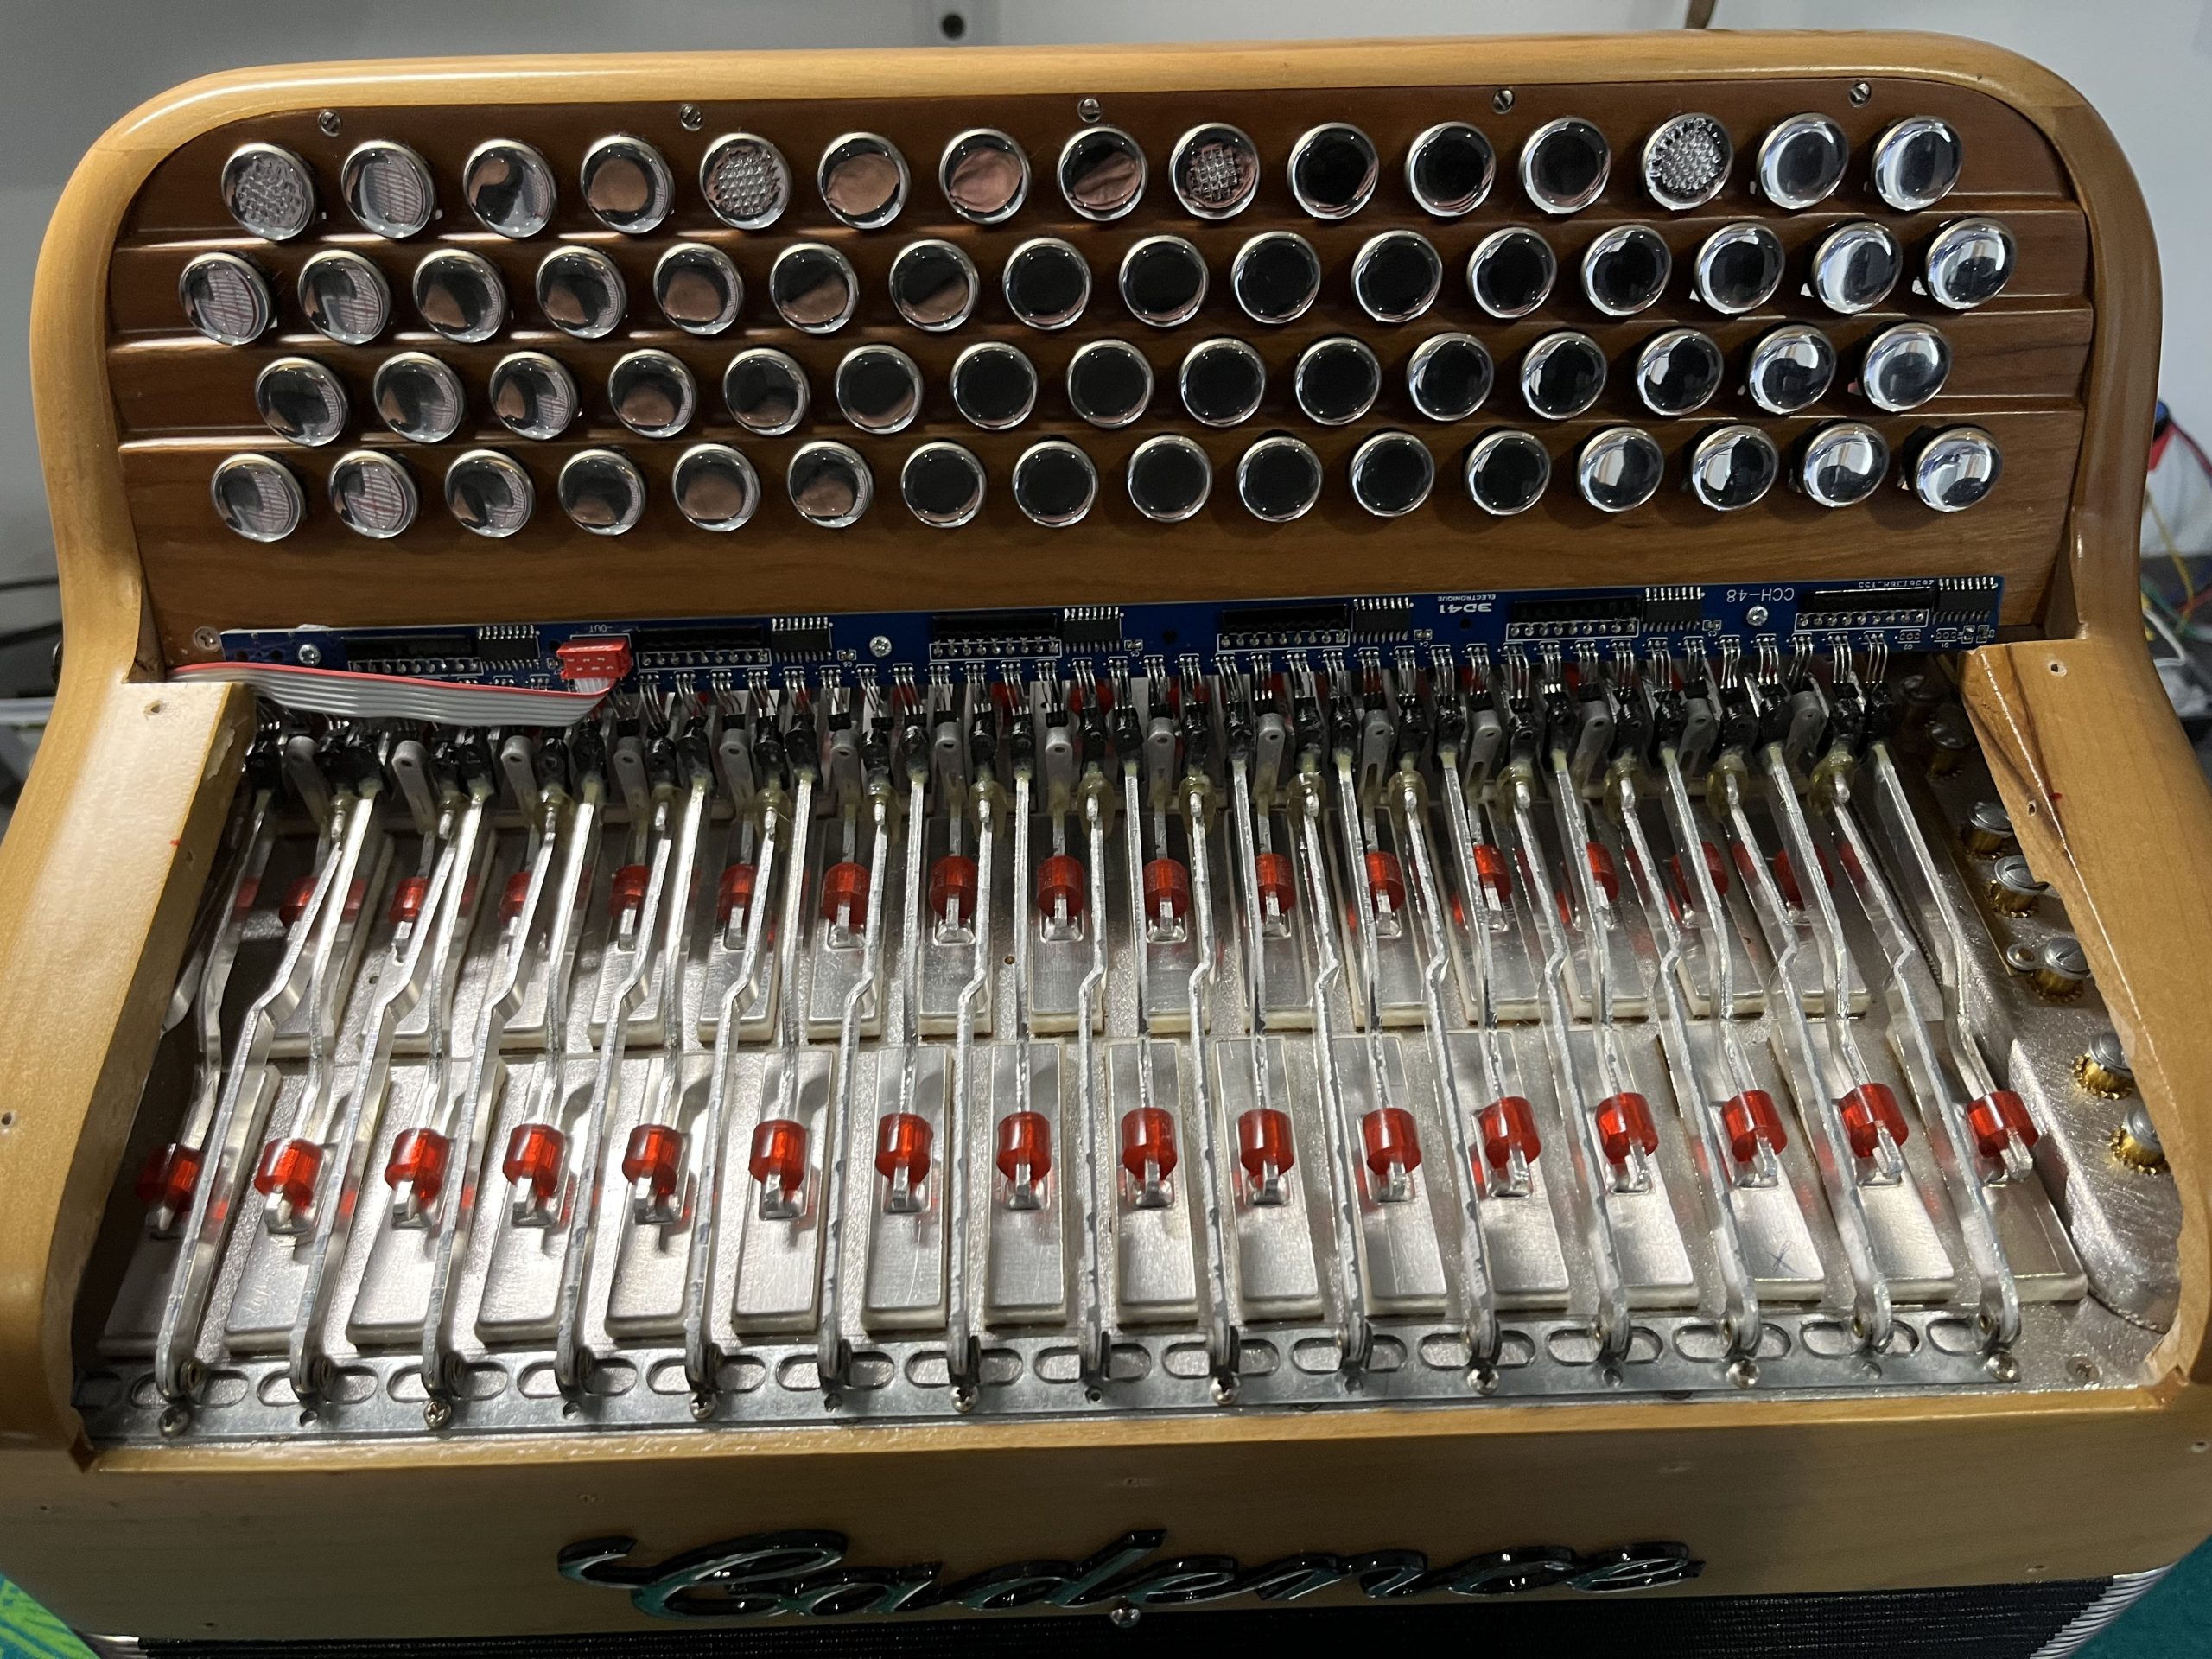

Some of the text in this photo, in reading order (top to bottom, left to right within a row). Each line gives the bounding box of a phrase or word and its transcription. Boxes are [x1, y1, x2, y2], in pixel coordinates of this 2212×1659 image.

[1437, 594, 1496, 602] ELECTRONIQUE
[1726, 588, 1795, 603] CCH-48
[1439, 602, 1493, 614] 3D41
[556, 1528, 1706, 1621] Cadence
